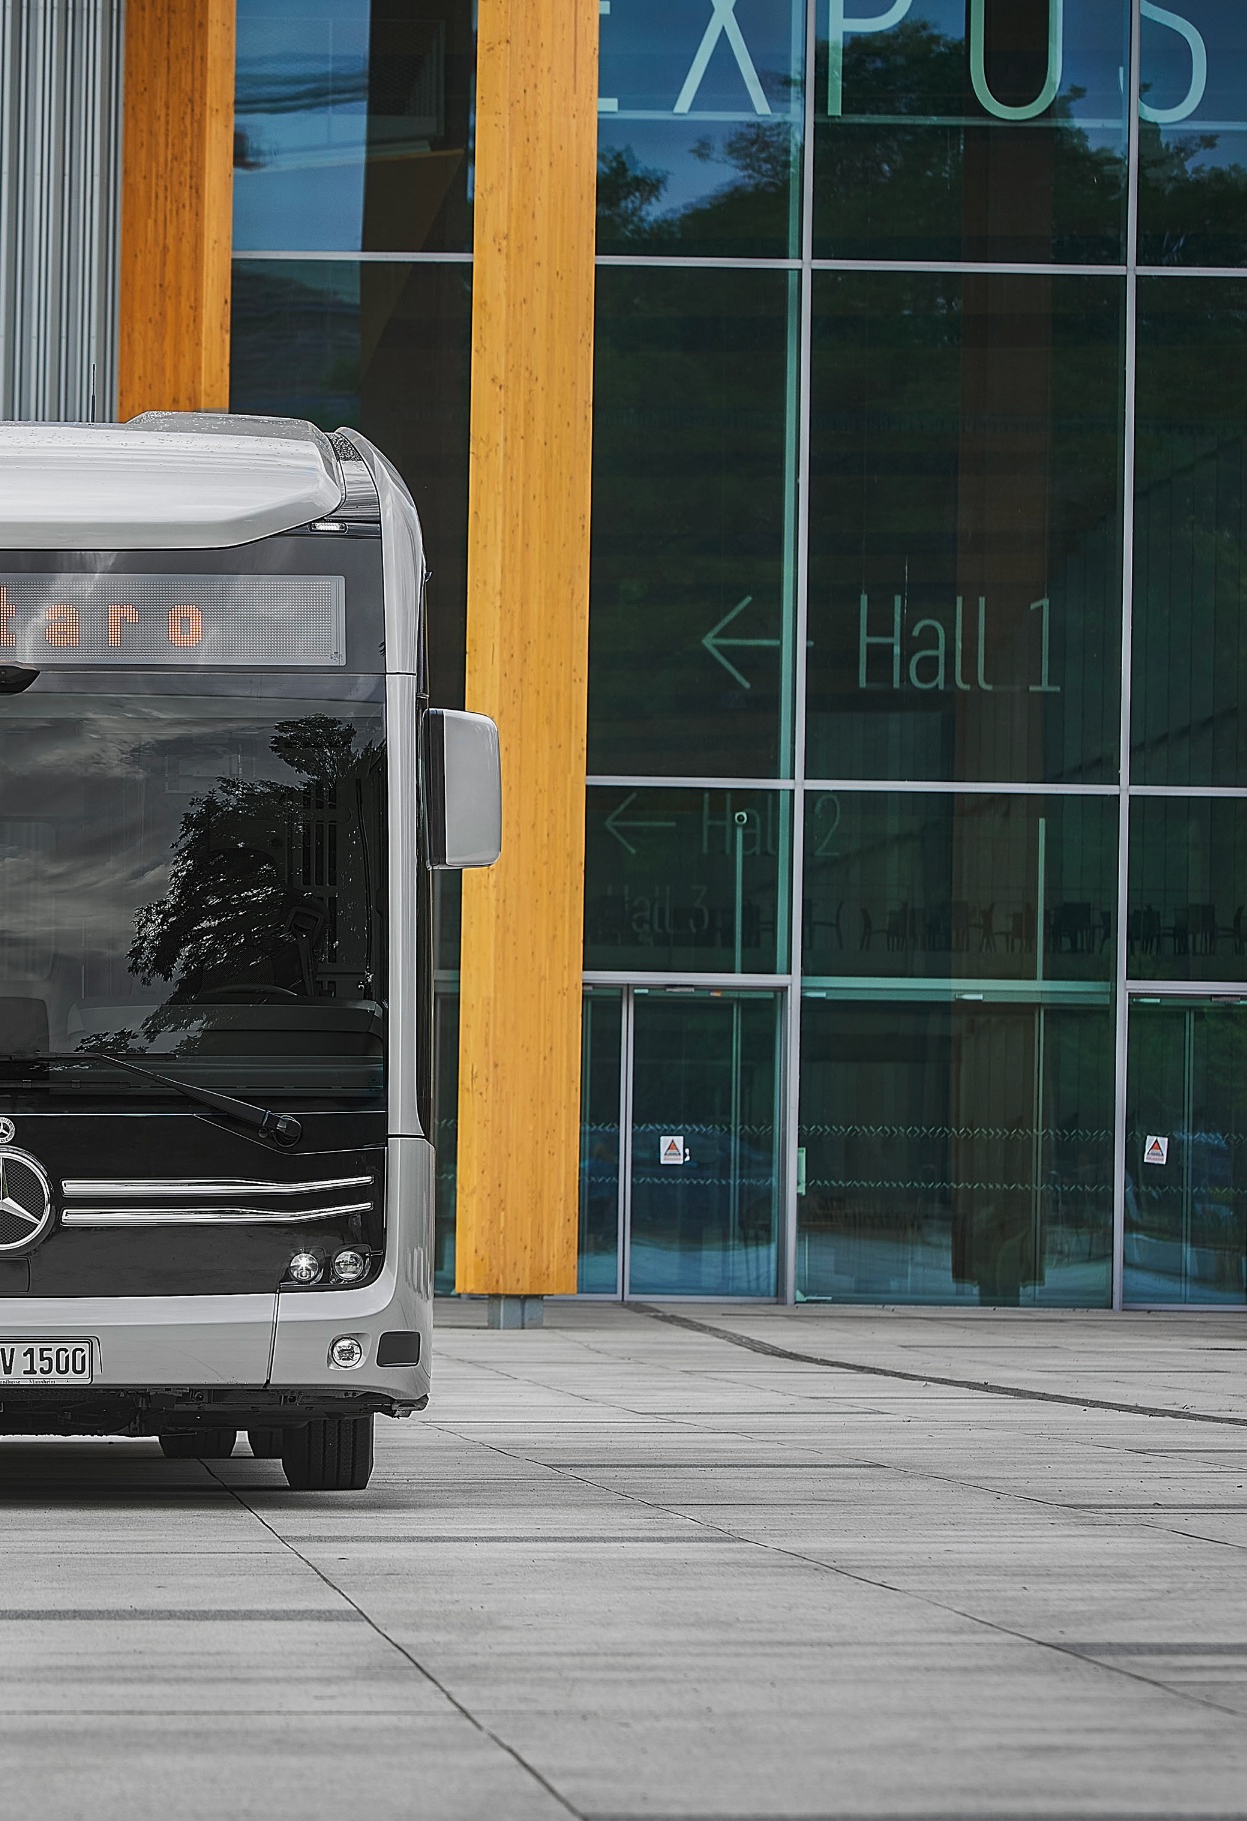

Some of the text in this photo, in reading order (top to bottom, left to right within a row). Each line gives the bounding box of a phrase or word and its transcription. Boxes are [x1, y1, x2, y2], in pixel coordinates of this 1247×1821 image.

[858, 593, 1061, 693] Hall 1
[702, 791, 841, 857] Hal 2
[22, 1347, 87, 1375] 1500
